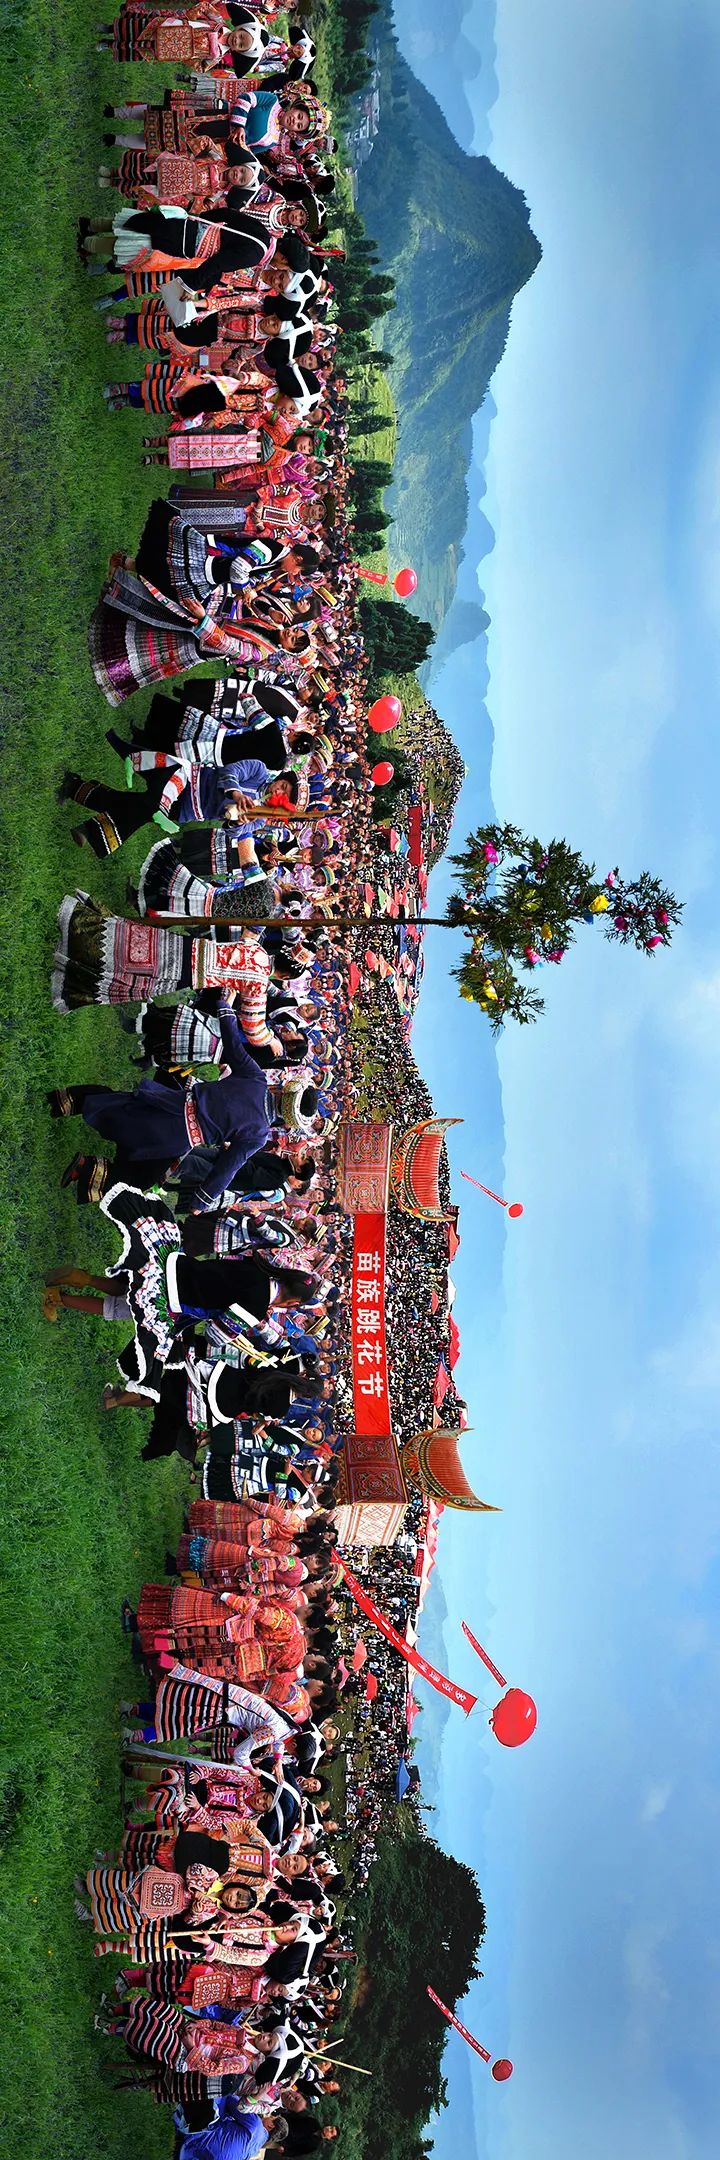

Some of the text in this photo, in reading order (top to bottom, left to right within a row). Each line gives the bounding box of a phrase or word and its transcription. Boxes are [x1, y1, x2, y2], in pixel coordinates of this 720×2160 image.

[356, 1250, 384, 1398] 苗族跳花节
